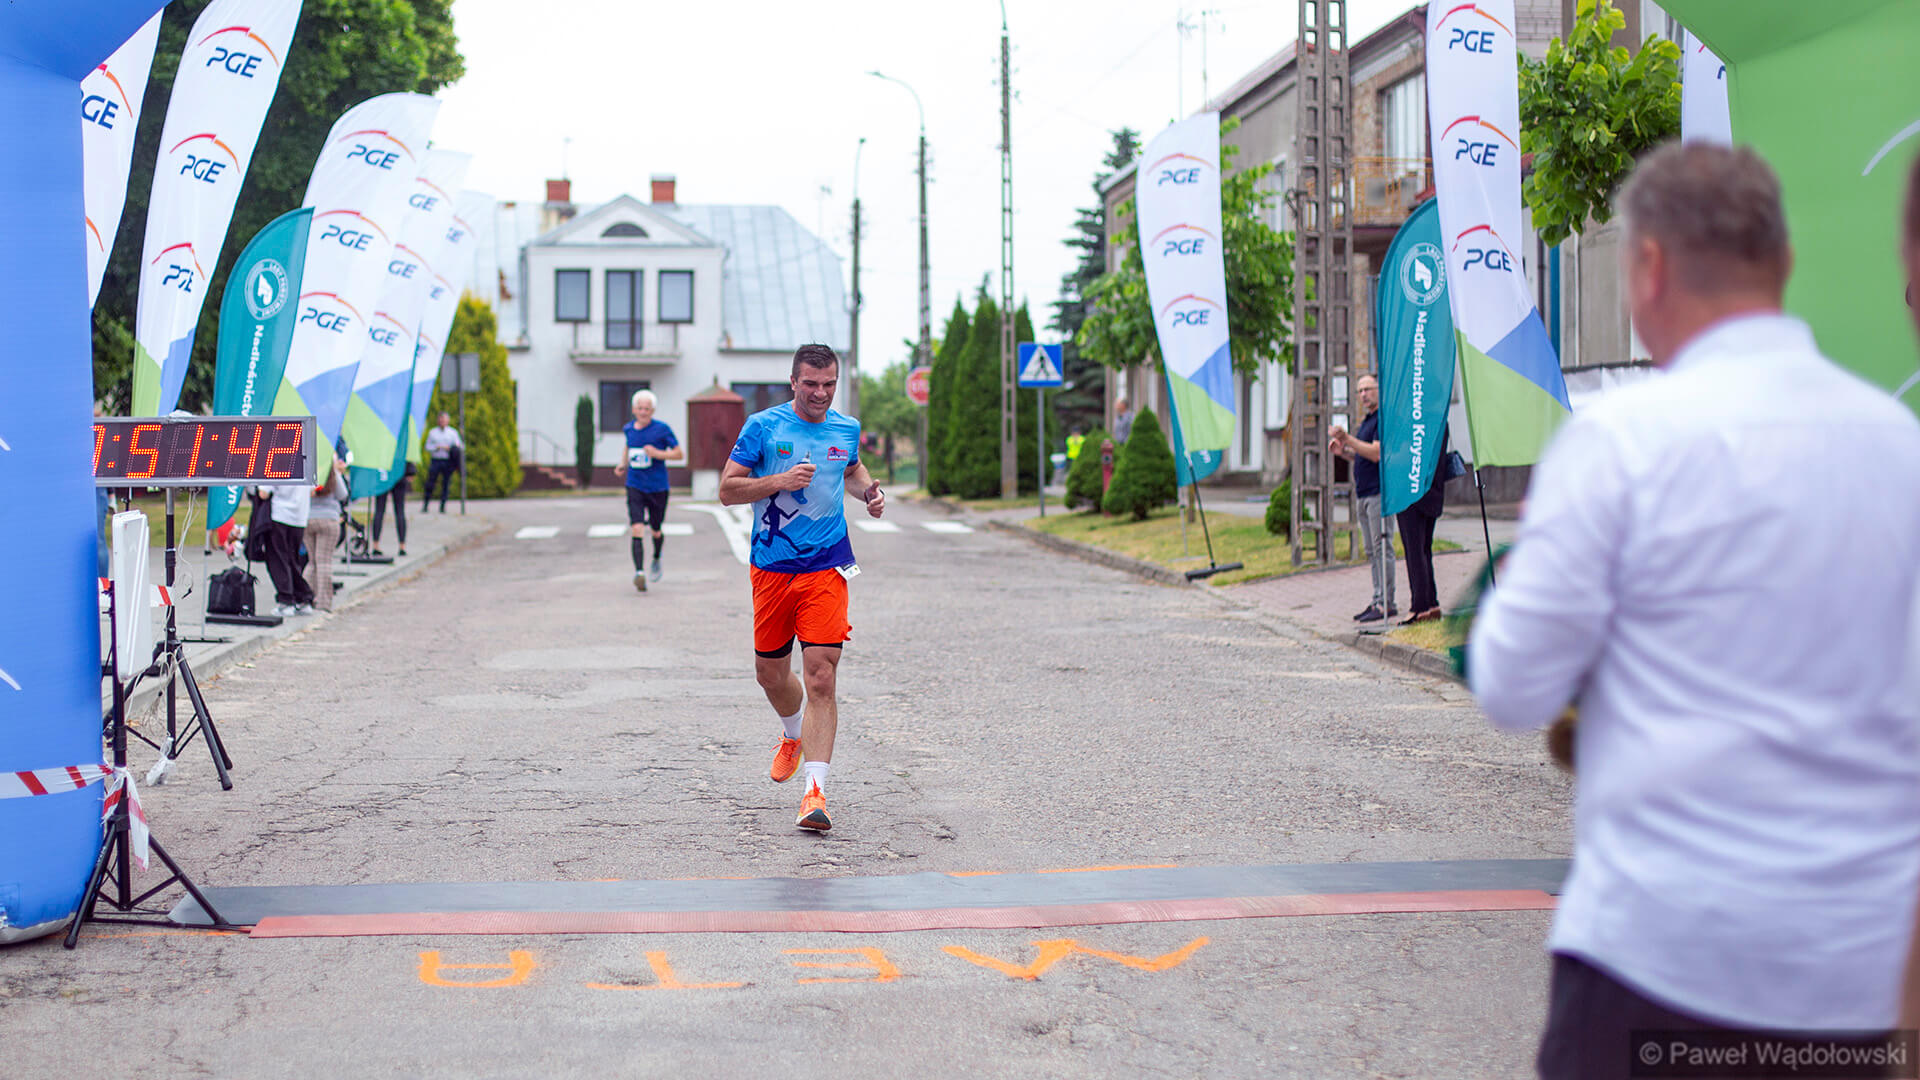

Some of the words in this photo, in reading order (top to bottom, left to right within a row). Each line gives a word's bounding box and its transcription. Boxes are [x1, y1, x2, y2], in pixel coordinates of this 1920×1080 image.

[1449, 28, 1495, 54] PGE
[205, 47, 262, 79] PGE
[80, 89, 119, 130] GE
[347, 144, 400, 170] PGE
[1455, 138, 1500, 167] PGE
[180, 154, 226, 184] PGE
[1158, 167, 1201, 188] PGE
[408, 193, 439, 212] GE
[320, 224, 374, 251] PGE
[1163, 238, 1205, 257] PGE
[387, 259, 418, 279] GE
[1463, 248, 1513, 273] PGE
[300, 307, 350, 333] PGE
[1172, 309, 1210, 328] PGE
[368, 326, 399, 347] GE
[1412, 311, 1427, 420] Nadleśnictwo
[1408, 424, 1425, 493] Knyszyn
